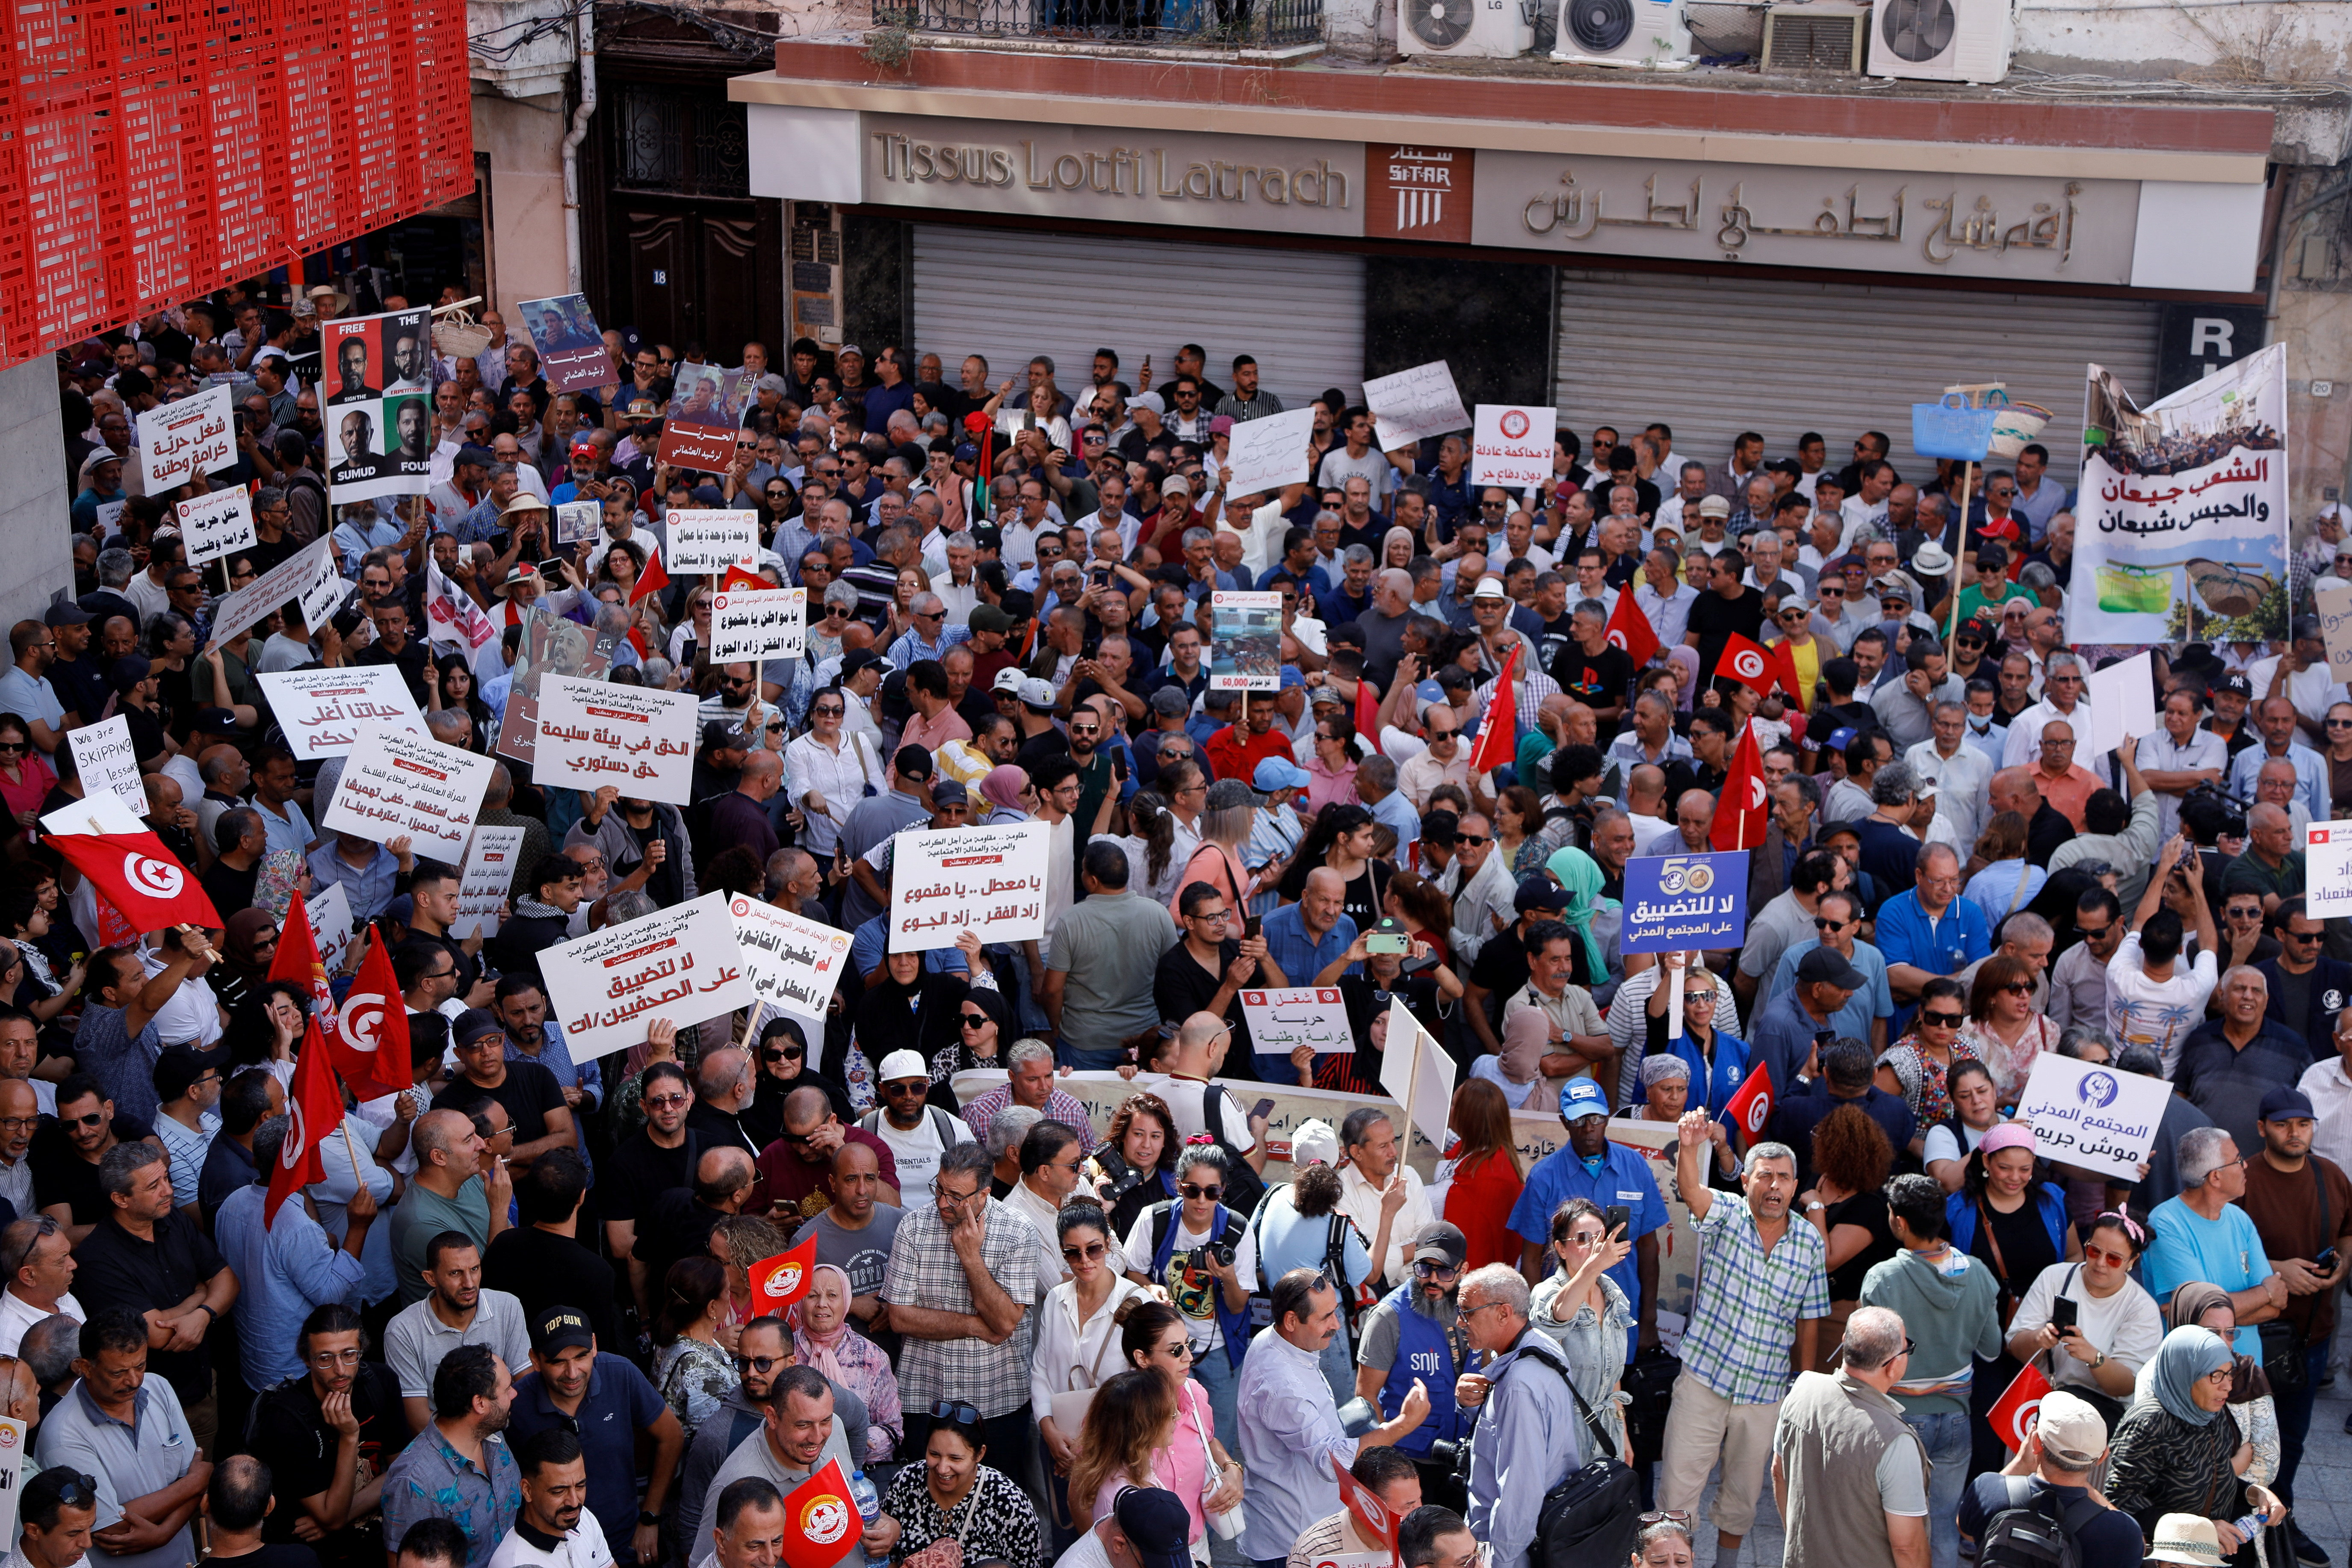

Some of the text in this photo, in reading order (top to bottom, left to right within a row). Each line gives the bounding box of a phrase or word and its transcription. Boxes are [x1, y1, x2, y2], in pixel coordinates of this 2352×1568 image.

[1390, 146, 1453, 163] سيتار
[871, 131, 1349, 208] Tissus Lotfi Latrach
[1389, 165, 1451, 186] SITAR
[1717, 183, 1908, 263] لطفي
[1923, 181, 2083, 270] أقمشة
[653, 270, 667, 283] 18
[339, 314, 419, 335] FREE THE
[2315, 384, 2328, 393] 20
[193, 416, 226, 445] شغل
[153, 441, 228, 481] كرامة وطنية
[672, 445, 722, 462] لرشيد العثماني
[1475, 444, 1551, 459] لا محاكمة عادلة
[337, 466, 376, 481] SUMUD
[1480, 470, 1542, 484] دون دفاع حر
[2101, 457, 2267, 508] الشعب جيعان
[195, 507, 239, 529] شغل حرية
[2098, 492, 2270, 538] والحبس شبعان
[191, 528, 249, 556] كرامة وطنية
[677, 528, 749, 543] وحدة وحدة يا عمال
[710, 558, 715, 567] و
[718, 555, 738, 567] القمع
[740, 555, 753, 564] ضد
[721, 608, 798, 631] يا مواطن يا مقموع
[715, 636, 802, 658] زاد الفقر زاد الجوع
[1223, 678, 1248, 687] 60,000
[298, 697, 404, 726] حياتنا أغلى
[74, 726, 114, 745] We are
[541, 720, 689, 757] الحق في بيئة سليمة
[417, 744, 426, 753] من
[427, 749, 447, 759] مقاومة
[455, 757, 474, 767] مقاومة
[565, 756, 659, 779] حق دستوري
[111, 777, 142, 795] TEACH
[345, 778, 381, 798] تهميشا
[362, 765, 467, 803] المرأة العاملة في قطاع الفلاحة
[380, 792, 404, 804] كفى
[446, 812, 470, 824] كفى
[438, 829, 462, 841] كفى
[1658, 857, 1714, 895] 50
[904, 874, 1041, 904] يا معطل يا مقموع
[901, 903, 1039, 933] زاد الفقر زاد الجوع
[1629, 894, 1734, 924] لا للتضييق
[567, 908, 700, 958] مقاومة مقاومة من أجل الكرامة
[625, 934, 656, 949] والعدالة
[1628, 922, 1732, 942] على المجتمع المدني
[680, 951, 695, 972] لا
[780, 943, 817, 966] تطبق
[814, 956, 832, 974] لم
[697, 966, 741, 993] على
[755, 973, 825, 1012] و المعطل في
[1274, 992, 1313, 1007] شغل
[1271, 1010, 1325, 1025] حرية
[1258, 1029, 1349, 1045] كرامة وطنية
[2027, 1101, 2149, 1139] المجتمع المدني
[2079, 1137, 2138, 1162] موش
[845, 1252, 861, 1269] ORIGINAL
[876, 1249, 888, 1259] BRAND
[852, 1285, 870, 1293] AUTHENTIC
[544, 1314, 582, 1336] TOP GUN
